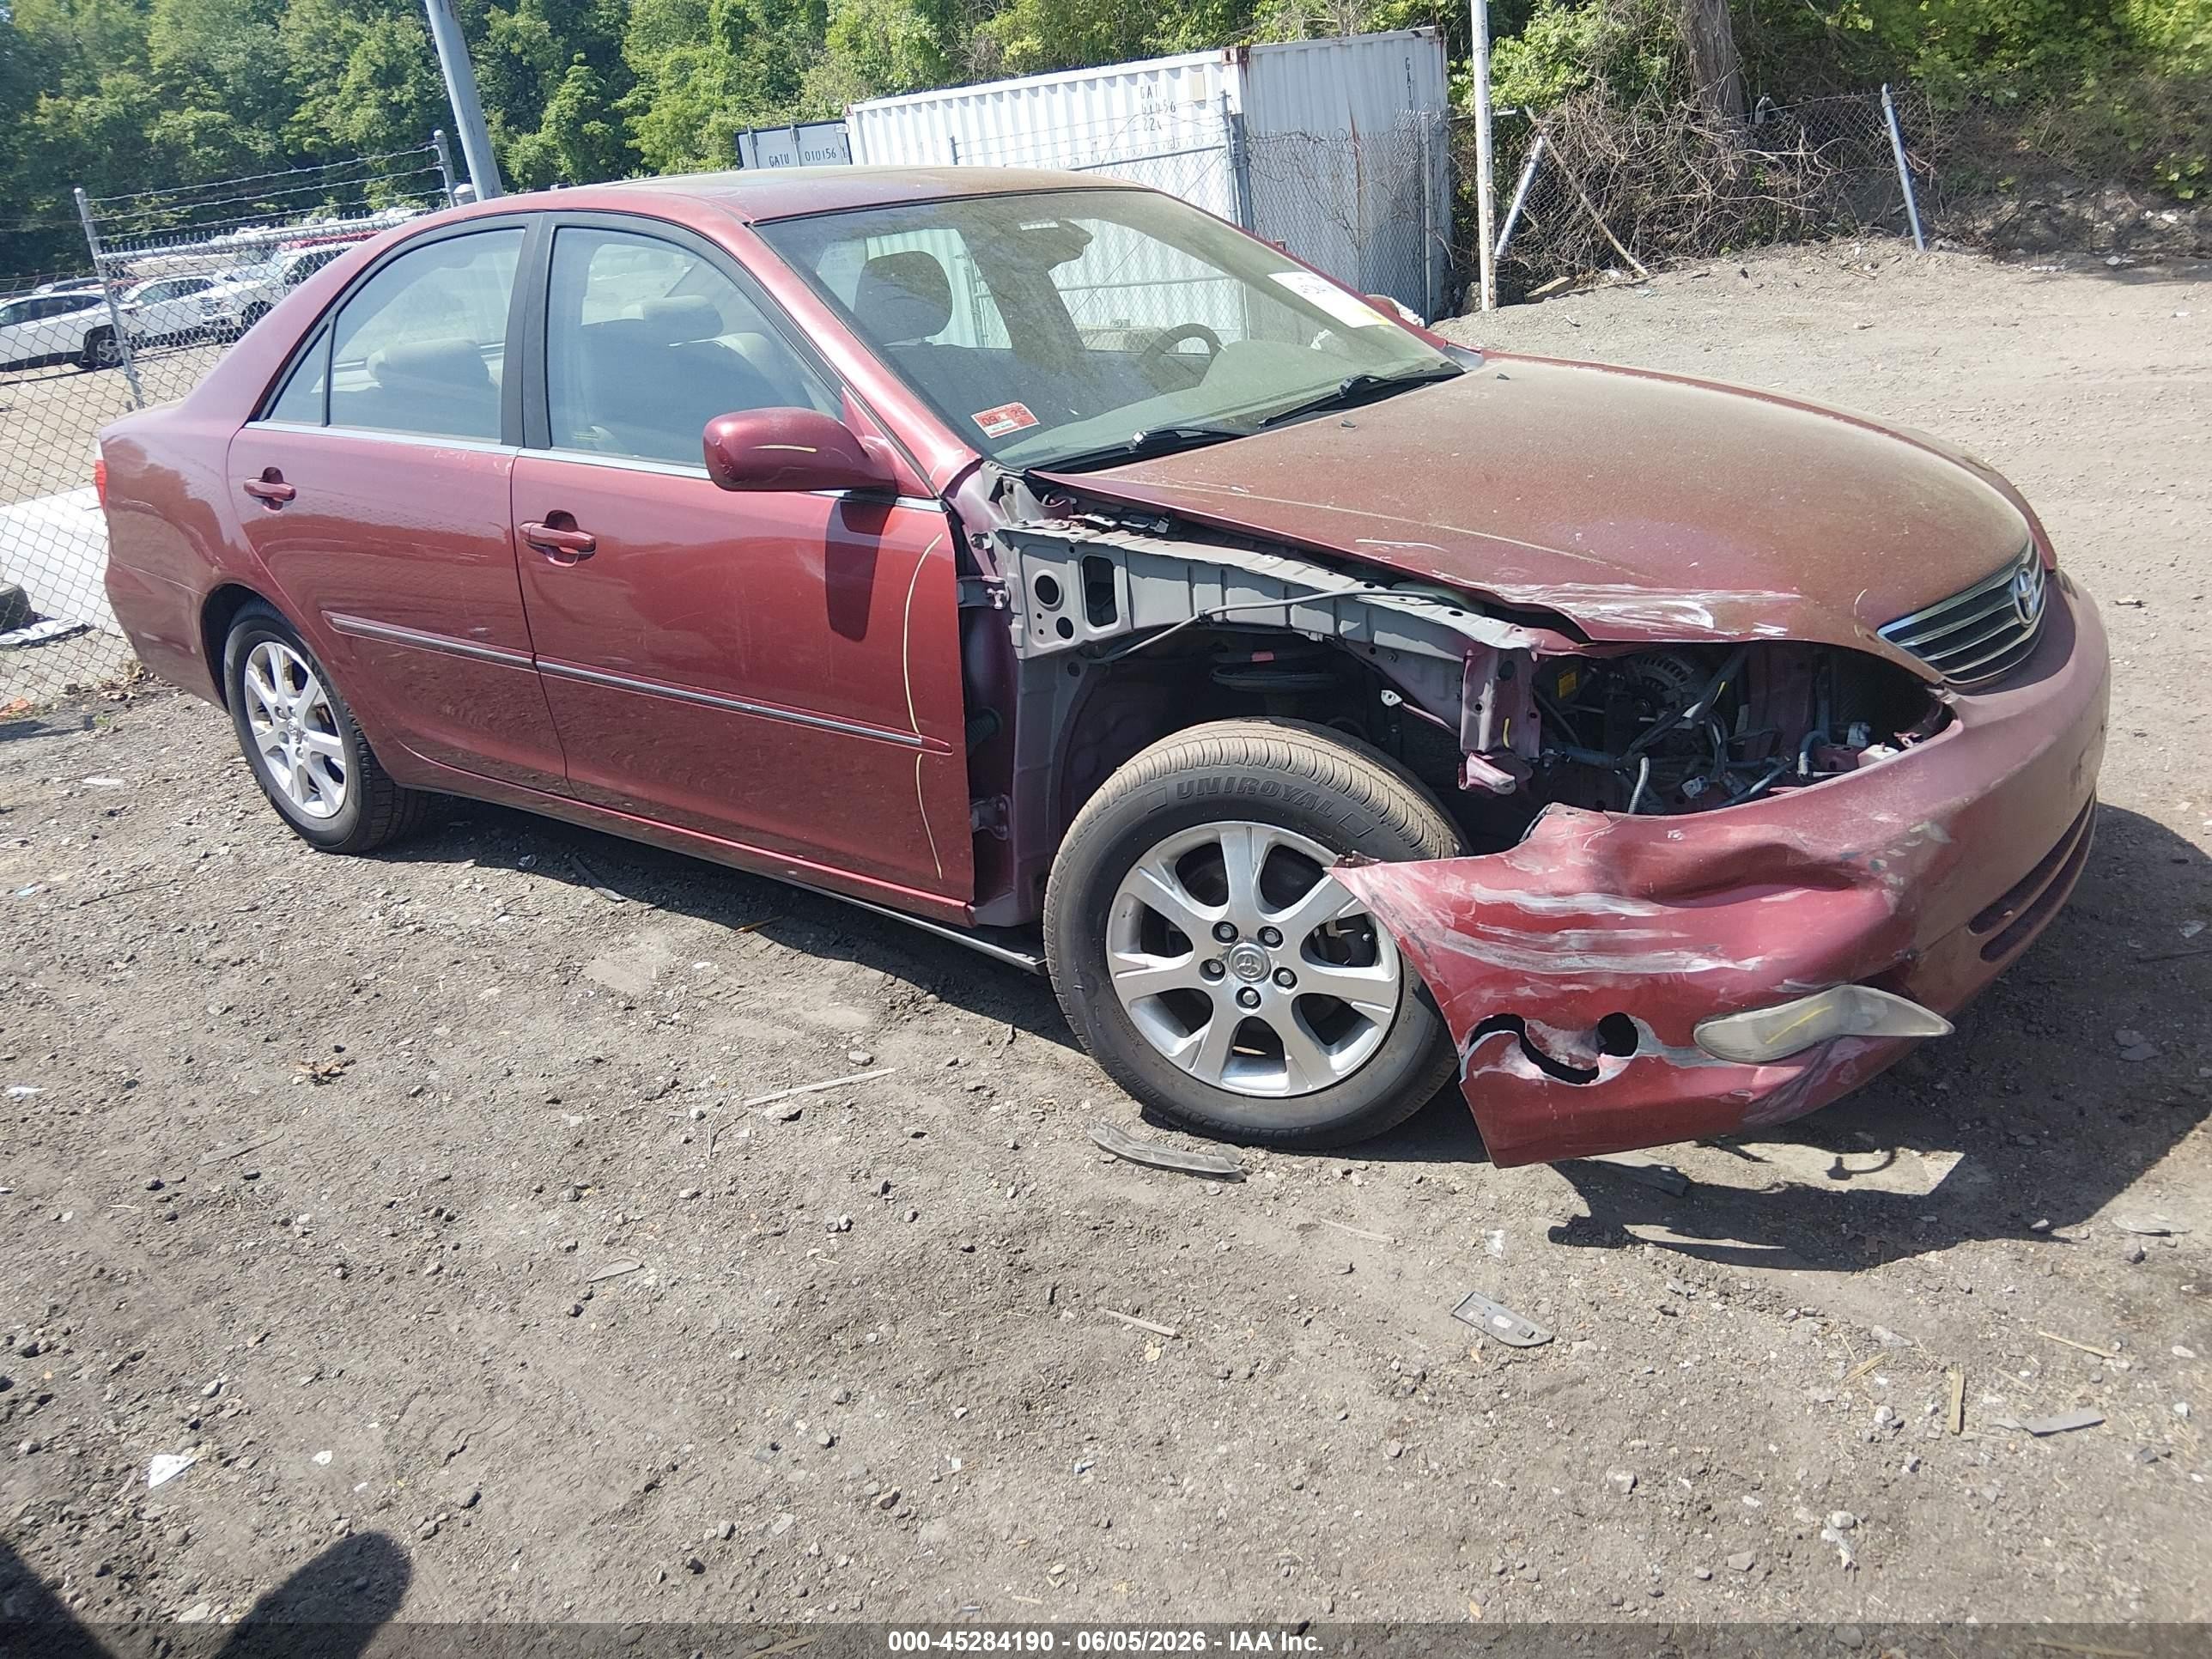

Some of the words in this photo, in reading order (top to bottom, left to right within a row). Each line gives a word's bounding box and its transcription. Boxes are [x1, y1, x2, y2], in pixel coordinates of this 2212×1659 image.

[769, 153, 790, 167] GATU
[805, 148, 836, 161] 010156
[981, 415, 999, 426] 09
[1176, 775, 1333, 817] UNIROYAL
